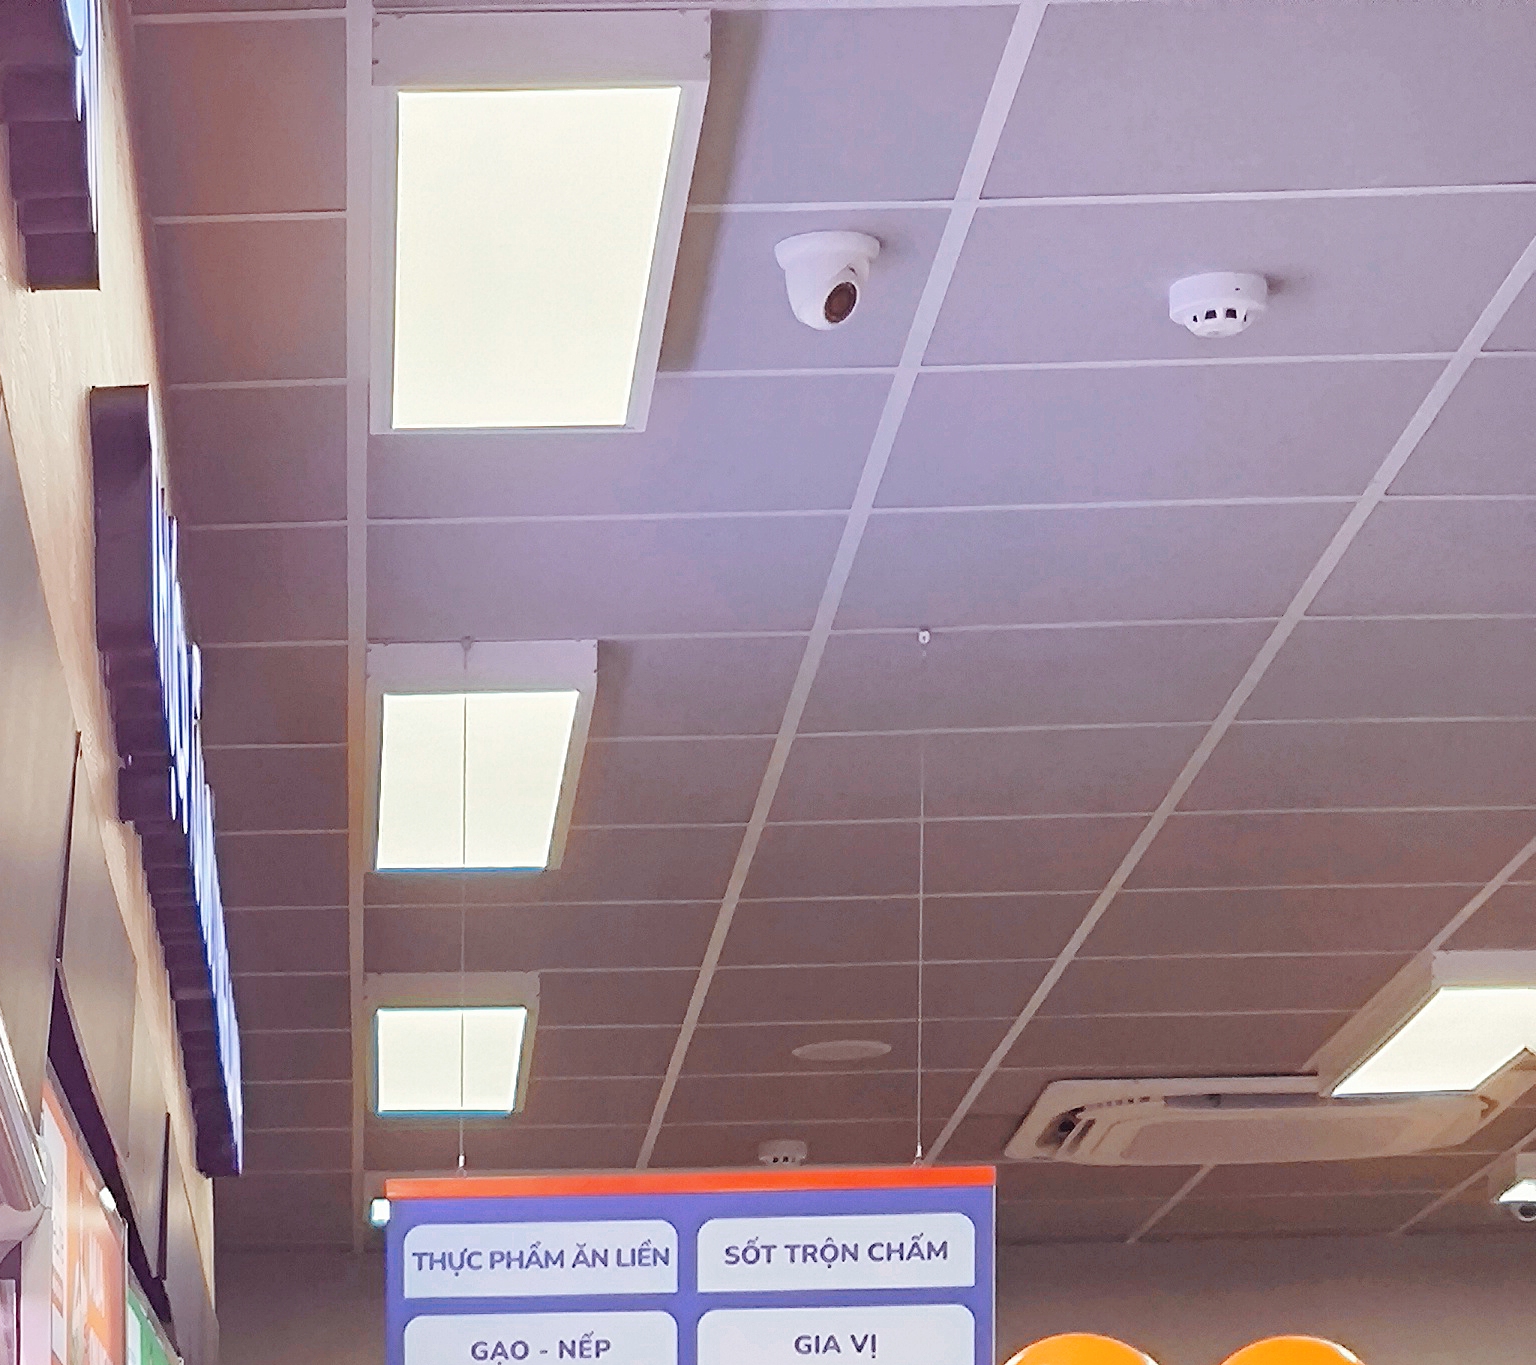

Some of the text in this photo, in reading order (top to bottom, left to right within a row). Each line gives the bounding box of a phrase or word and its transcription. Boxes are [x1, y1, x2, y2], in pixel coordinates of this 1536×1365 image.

[412, 1239, 670, 1277] THỰC PHẨM ĂN LIỀN
[724, 1232, 949, 1268] SỐT TRỘN CHẤM
[470, 1340, 530, 1365] GẠO
[558, 1331, 612, 1359] NẾP
[794, 1333, 878, 1359] GIA VỊ
